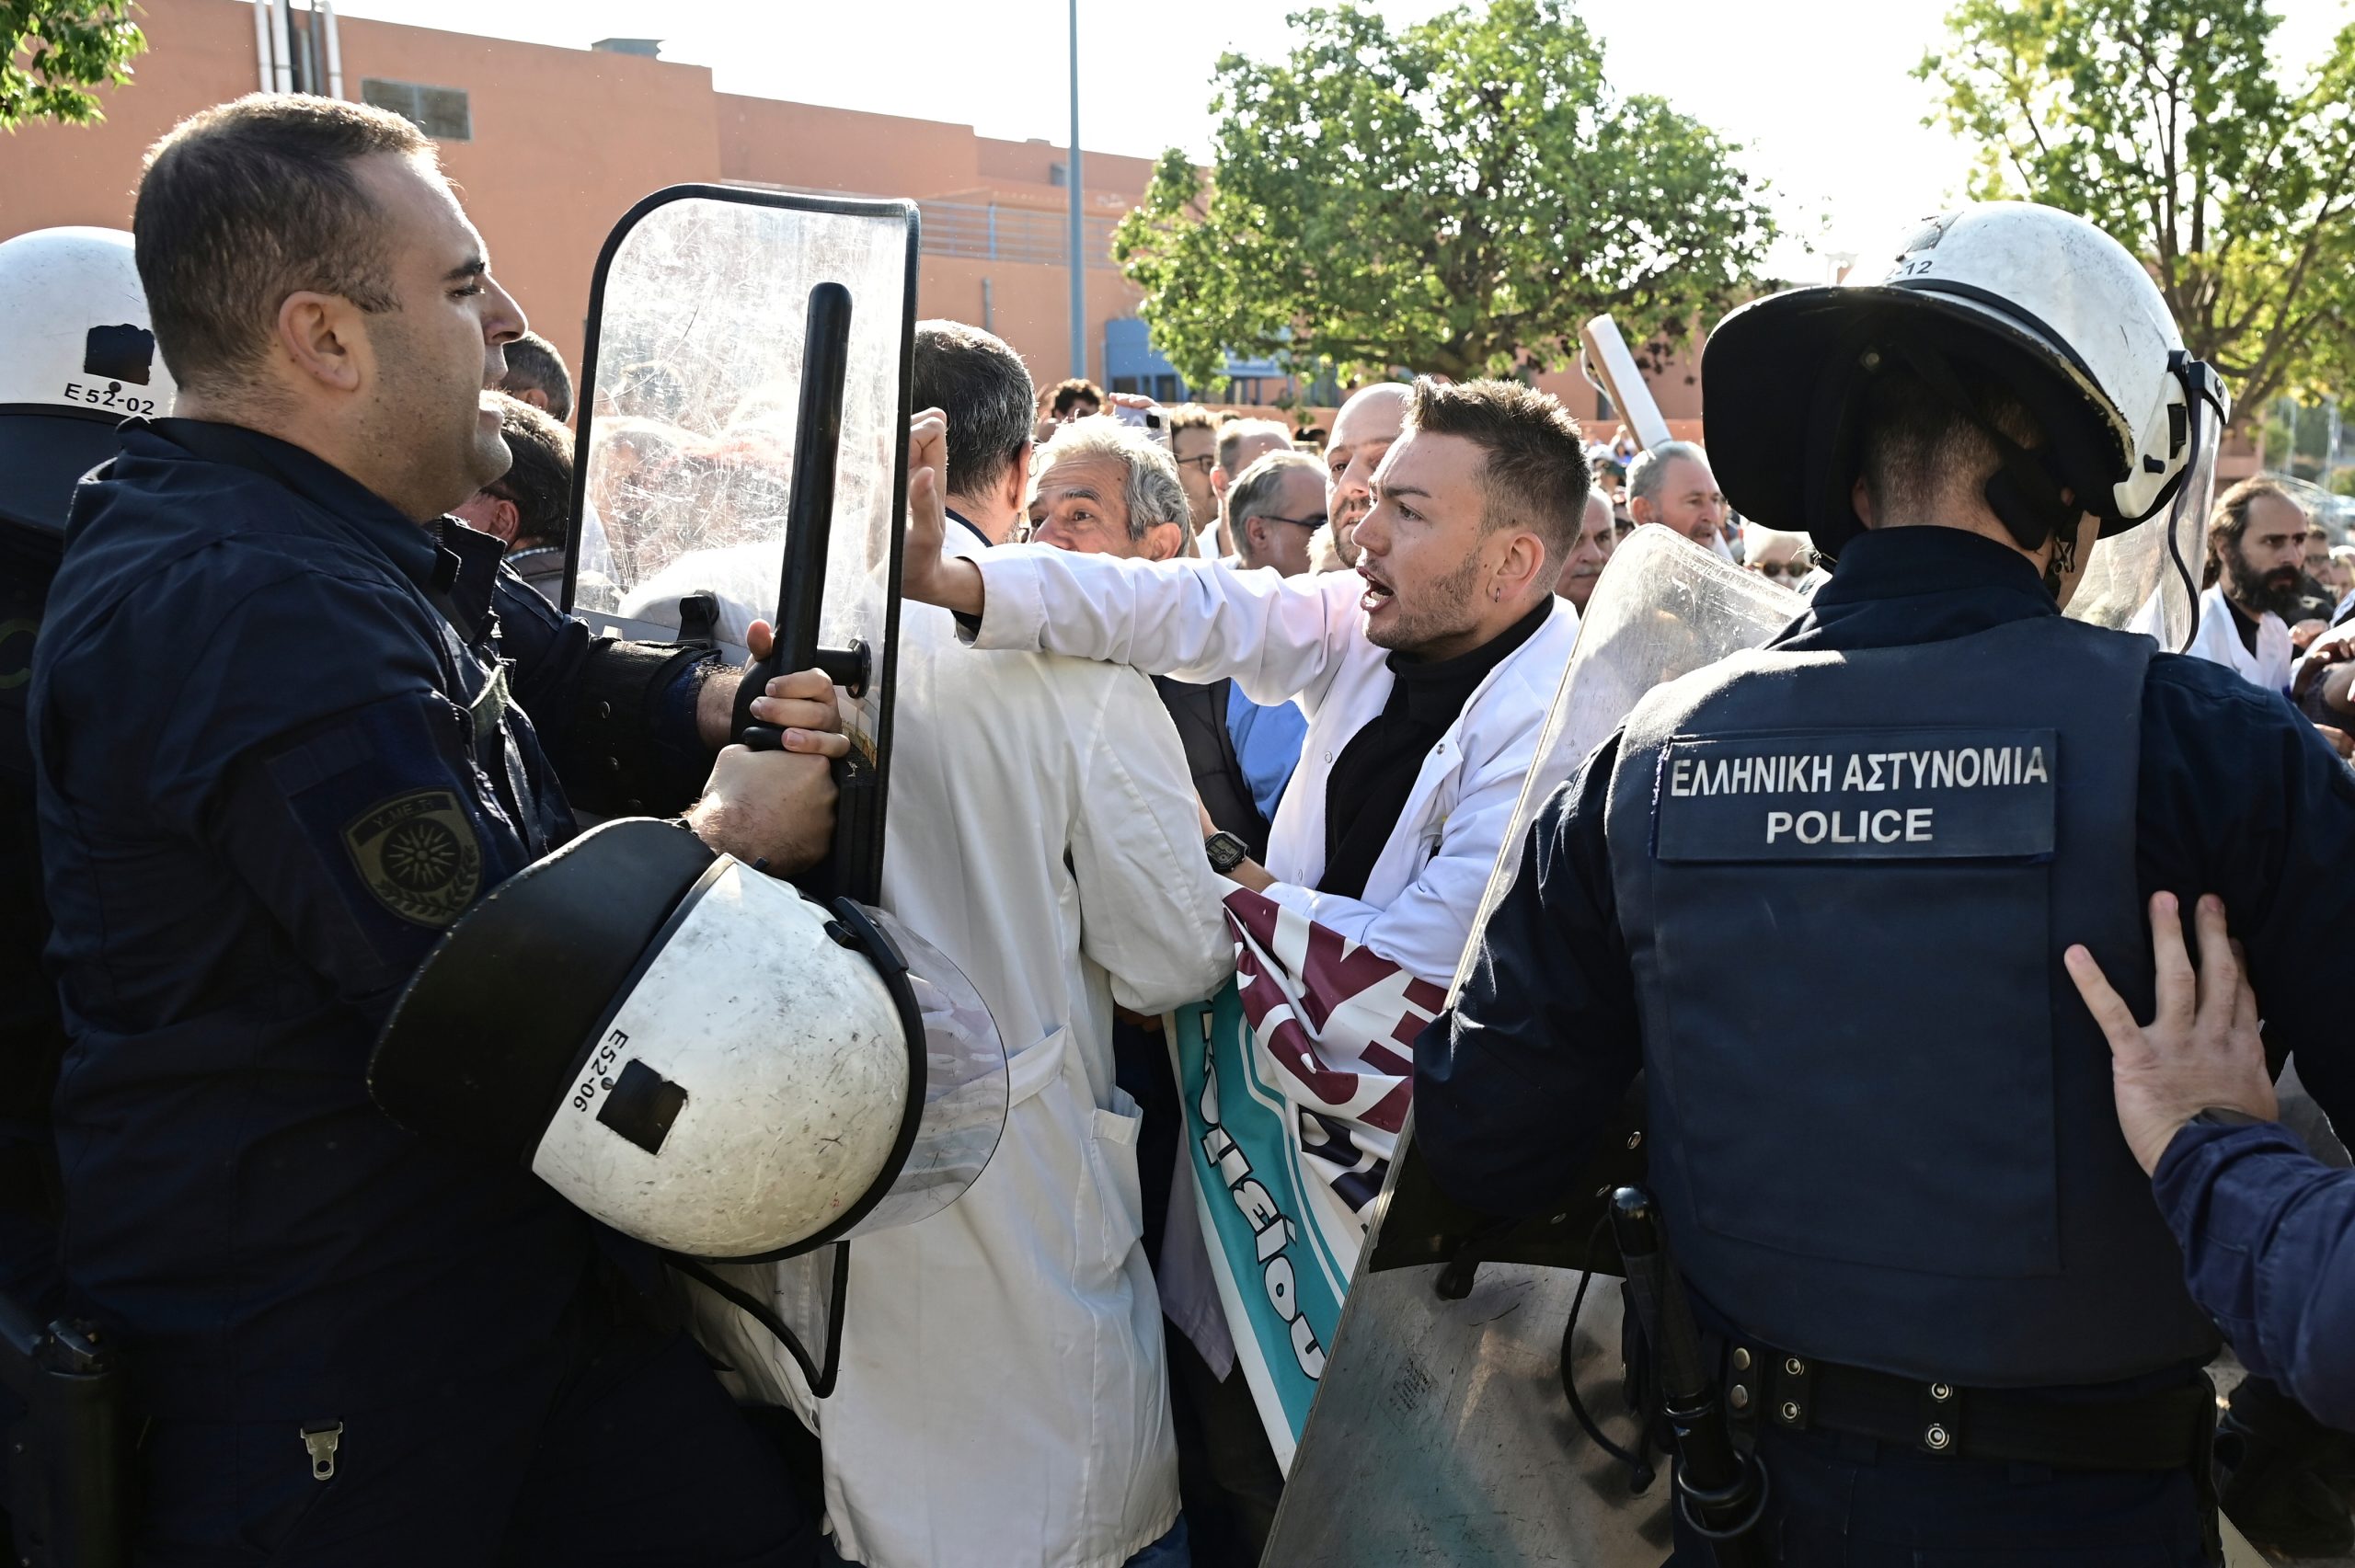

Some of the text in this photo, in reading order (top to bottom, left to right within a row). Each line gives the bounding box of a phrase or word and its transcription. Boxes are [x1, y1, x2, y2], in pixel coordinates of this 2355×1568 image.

[1671, 746, 2049, 796] ΕΛΛΗΝΙΚΗ ΑΣΤΥΝΟΜΙΑ
[1766, 807, 1934, 844] POLICE
[573, 1028, 630, 1113] E52-06
